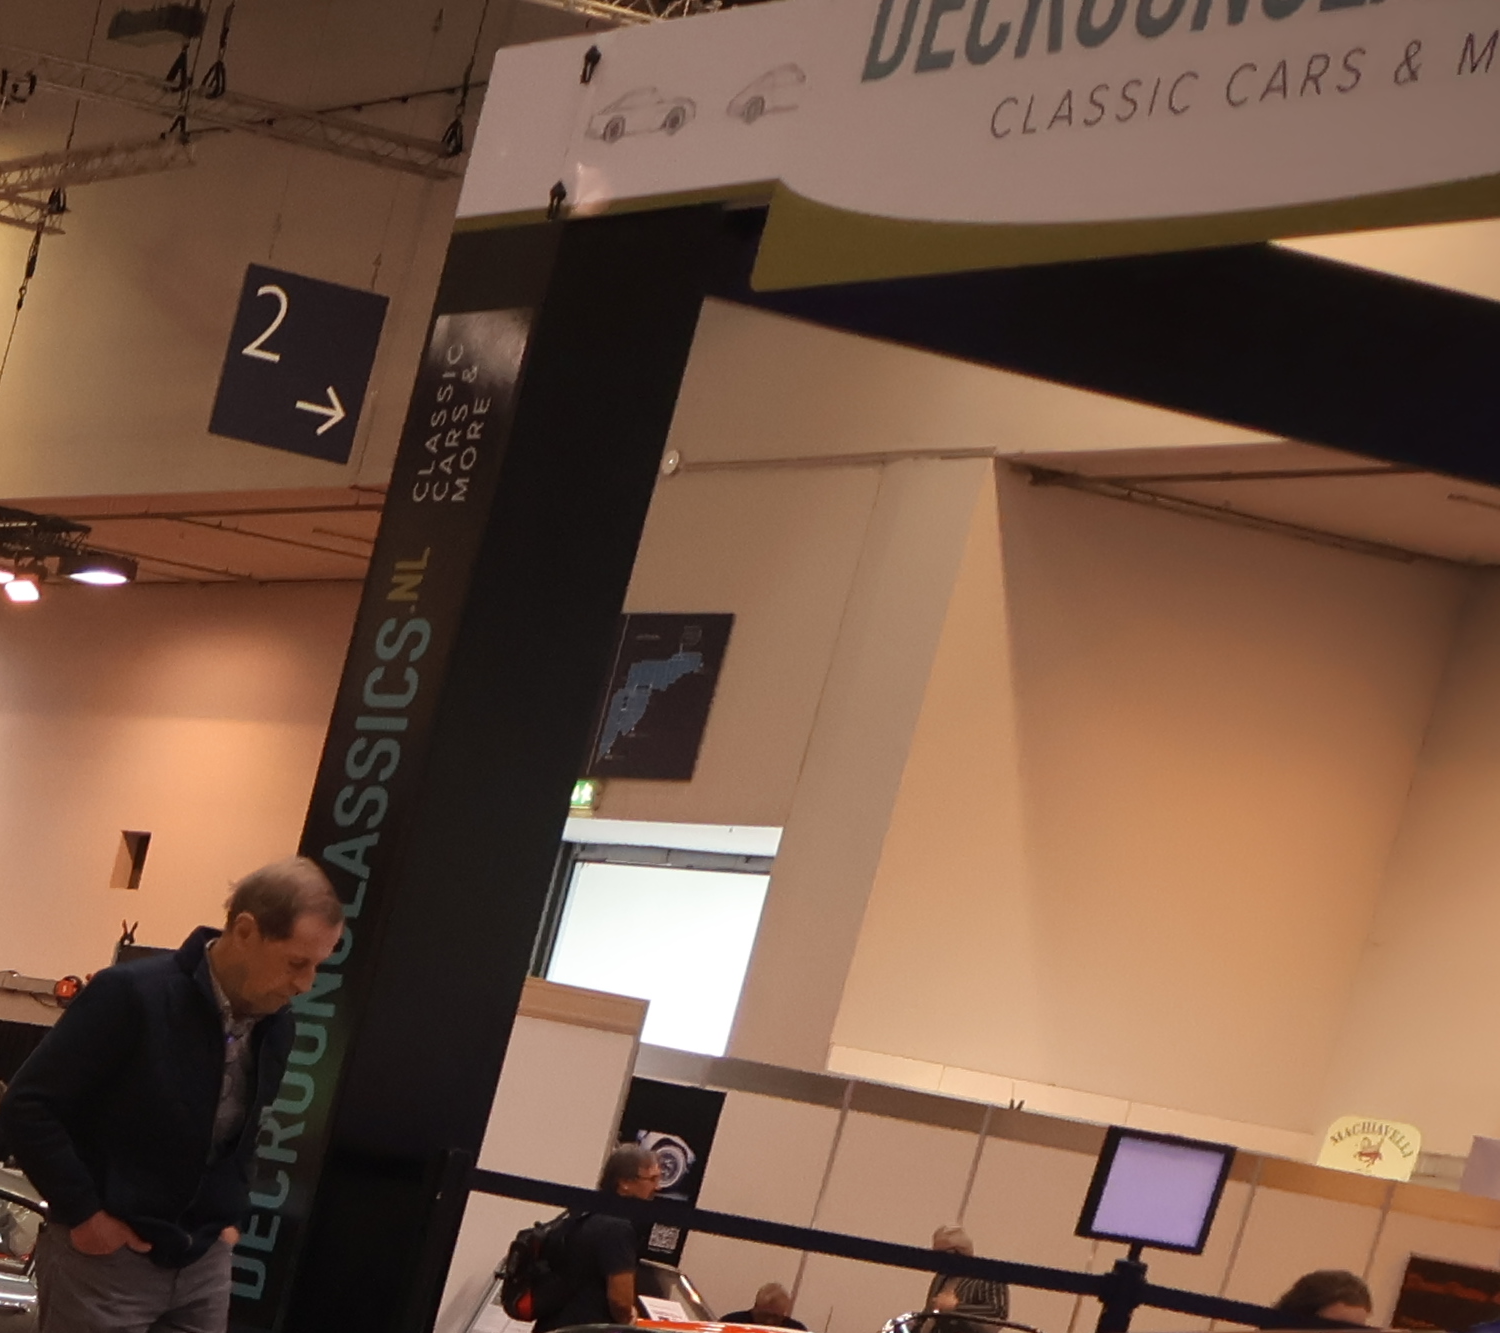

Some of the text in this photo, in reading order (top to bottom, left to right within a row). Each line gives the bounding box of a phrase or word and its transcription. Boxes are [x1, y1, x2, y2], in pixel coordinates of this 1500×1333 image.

[990, 71, 1199, 139] CLASSIC
[1226, 48, 1366, 108] CARS
[1394, 39, 1423, 85] &
[242, 285, 289, 363] 2
[413, 343, 465, 502] CLASSIC
[433, 404, 470, 500] CARS
[451, 397, 492, 501] MORE
